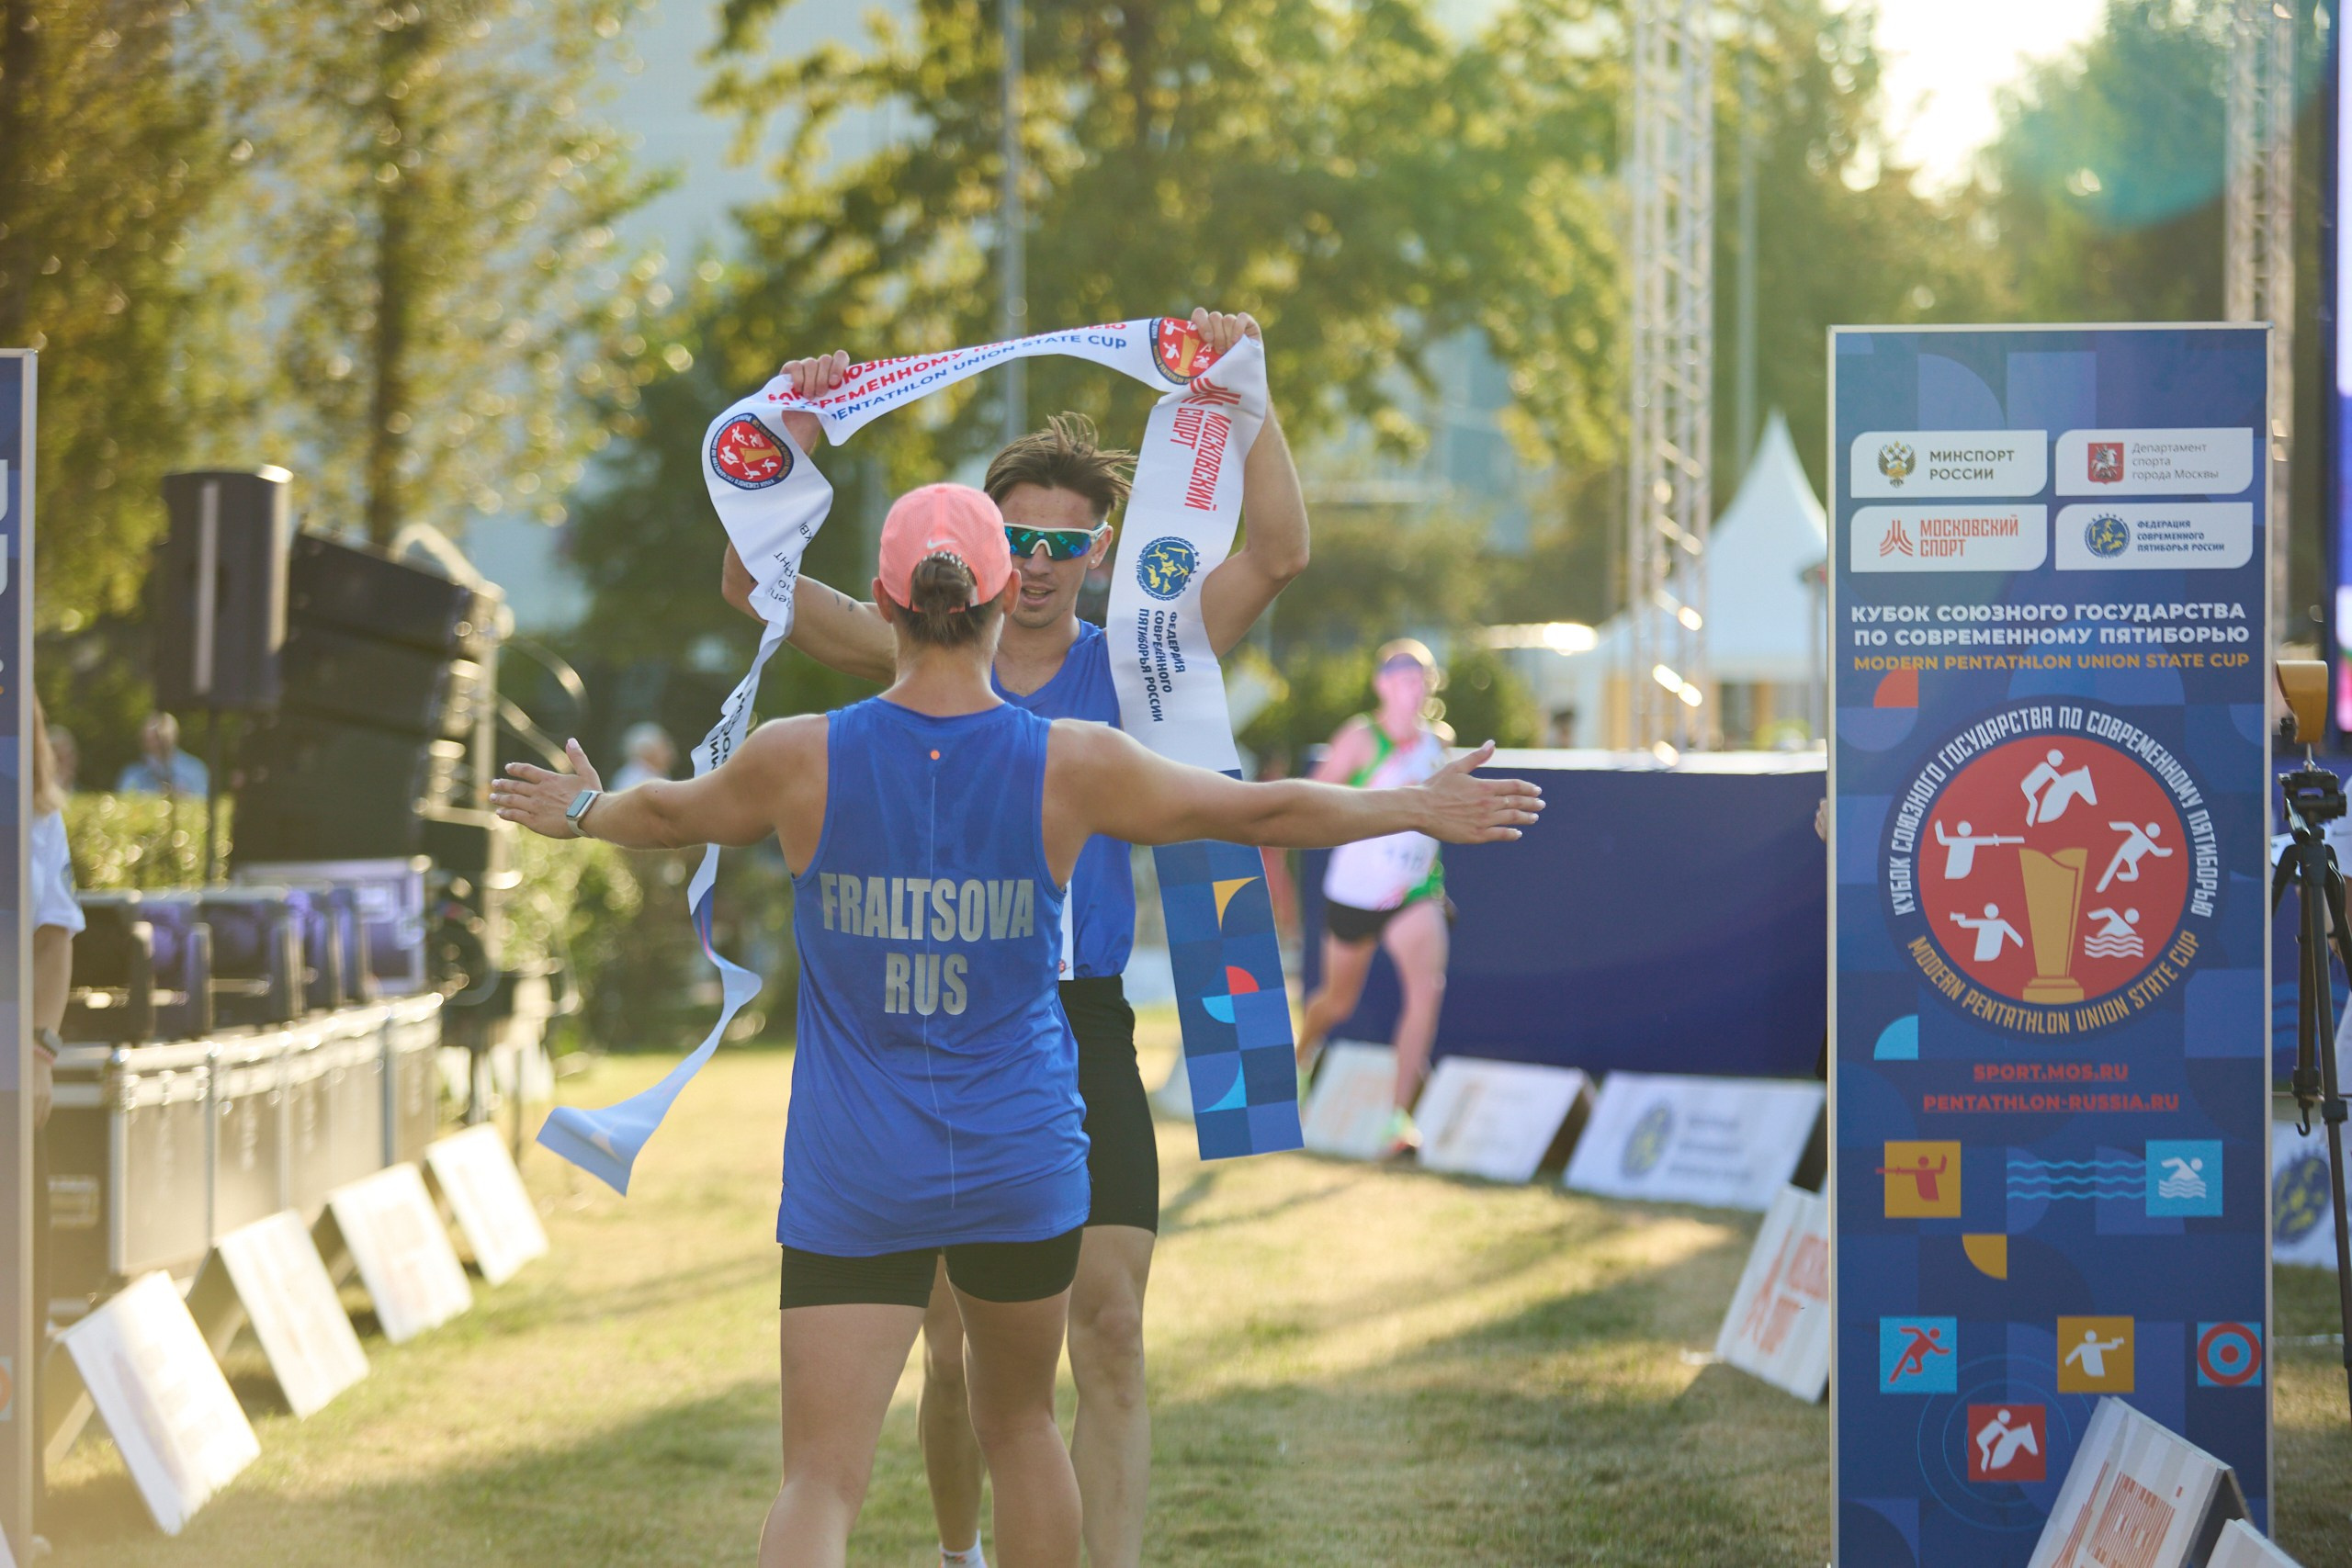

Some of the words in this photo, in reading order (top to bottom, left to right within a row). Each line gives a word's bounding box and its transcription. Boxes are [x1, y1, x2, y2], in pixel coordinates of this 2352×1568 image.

[831, 369, 947, 421] ENTATHLON
[954, 345, 1015, 371] UNION
[1022, 334, 1081, 348] STATE
[1088, 334, 1127, 349] CUP
[1170, 408, 1204, 449] СПОРТ
[1184, 412, 1232, 511] МОСКОВСКИЙ
[1929, 450, 2015, 462] МИНСПОРТ
[2132, 443, 2207, 457] Департамент
[1929, 468, 1995, 480] РОССИИ
[2132, 458, 2171, 467] спорта
[2132, 471, 2172, 481] города
[2175, 468, 2219, 479] Москвы
[1920, 514, 2018, 537] МОСКОВСКИЙ
[2137, 520, 2191, 530] ФЕДЕРАЦИЯ
[2137, 532, 2205, 541] СОВРЕМЕННОГО
[1920, 539, 1966, 558] СПОРТ
[2137, 543, 2188, 553] ПЯТИБОРЬЯ
[2191, 543, 2225, 552] РОССИИ
[1851, 604, 1930, 622] КУБОК
[1936, 604, 2068, 622] СОЮЗНОГО
[2075, 603, 2246, 623] ГОСУДАРСТВА
[1137, 608, 1153, 673] ПЯТИБОРЬЯ
[1854, 628, 1888, 646] ПО
[1894, 627, 2092, 646] СОВРЕМЕННОМУ
[2099, 626, 2250, 644] ПЯТИБОРЬЮ
[1854, 655, 1939, 671] MODERN
[1944, 655, 2072, 670] PENTATHLON
[2077, 654, 2141, 669] UNION
[2146, 653, 2205, 668] STATE
[2210, 652, 2250, 668] CUP
[1144, 676, 1164, 723] РОССИИ
[2059, 705, 2083, 730] ПО
[1938, 705, 2053, 772] ГОСУДАРСТВА
[2086, 710, 2203, 809] СОВРЕМЕННОМУ
[1891, 761, 1948, 853] СОЮЗНОГО
[2187, 808, 2219, 918] ПЯТИБОРЬЮ
[1889, 855, 1917, 916] КУБОК
[820, 873, 1035, 942] FRALTSOVA
[884, 952, 968, 1016] RUS
[1907, 935, 1967, 1000] MODERN
[1962, 990, 2070, 1034] PENTATHLON
[2075, 995, 2131, 1032] UNION
[2128, 961, 2178, 1010] STATE
[2168, 929, 2200, 968] CUP
[1973, 1064, 2129, 1081] SPORT.MOS.RU
[1923, 1094, 2179, 1111] PENTATHLON-RUSSIA.RU
